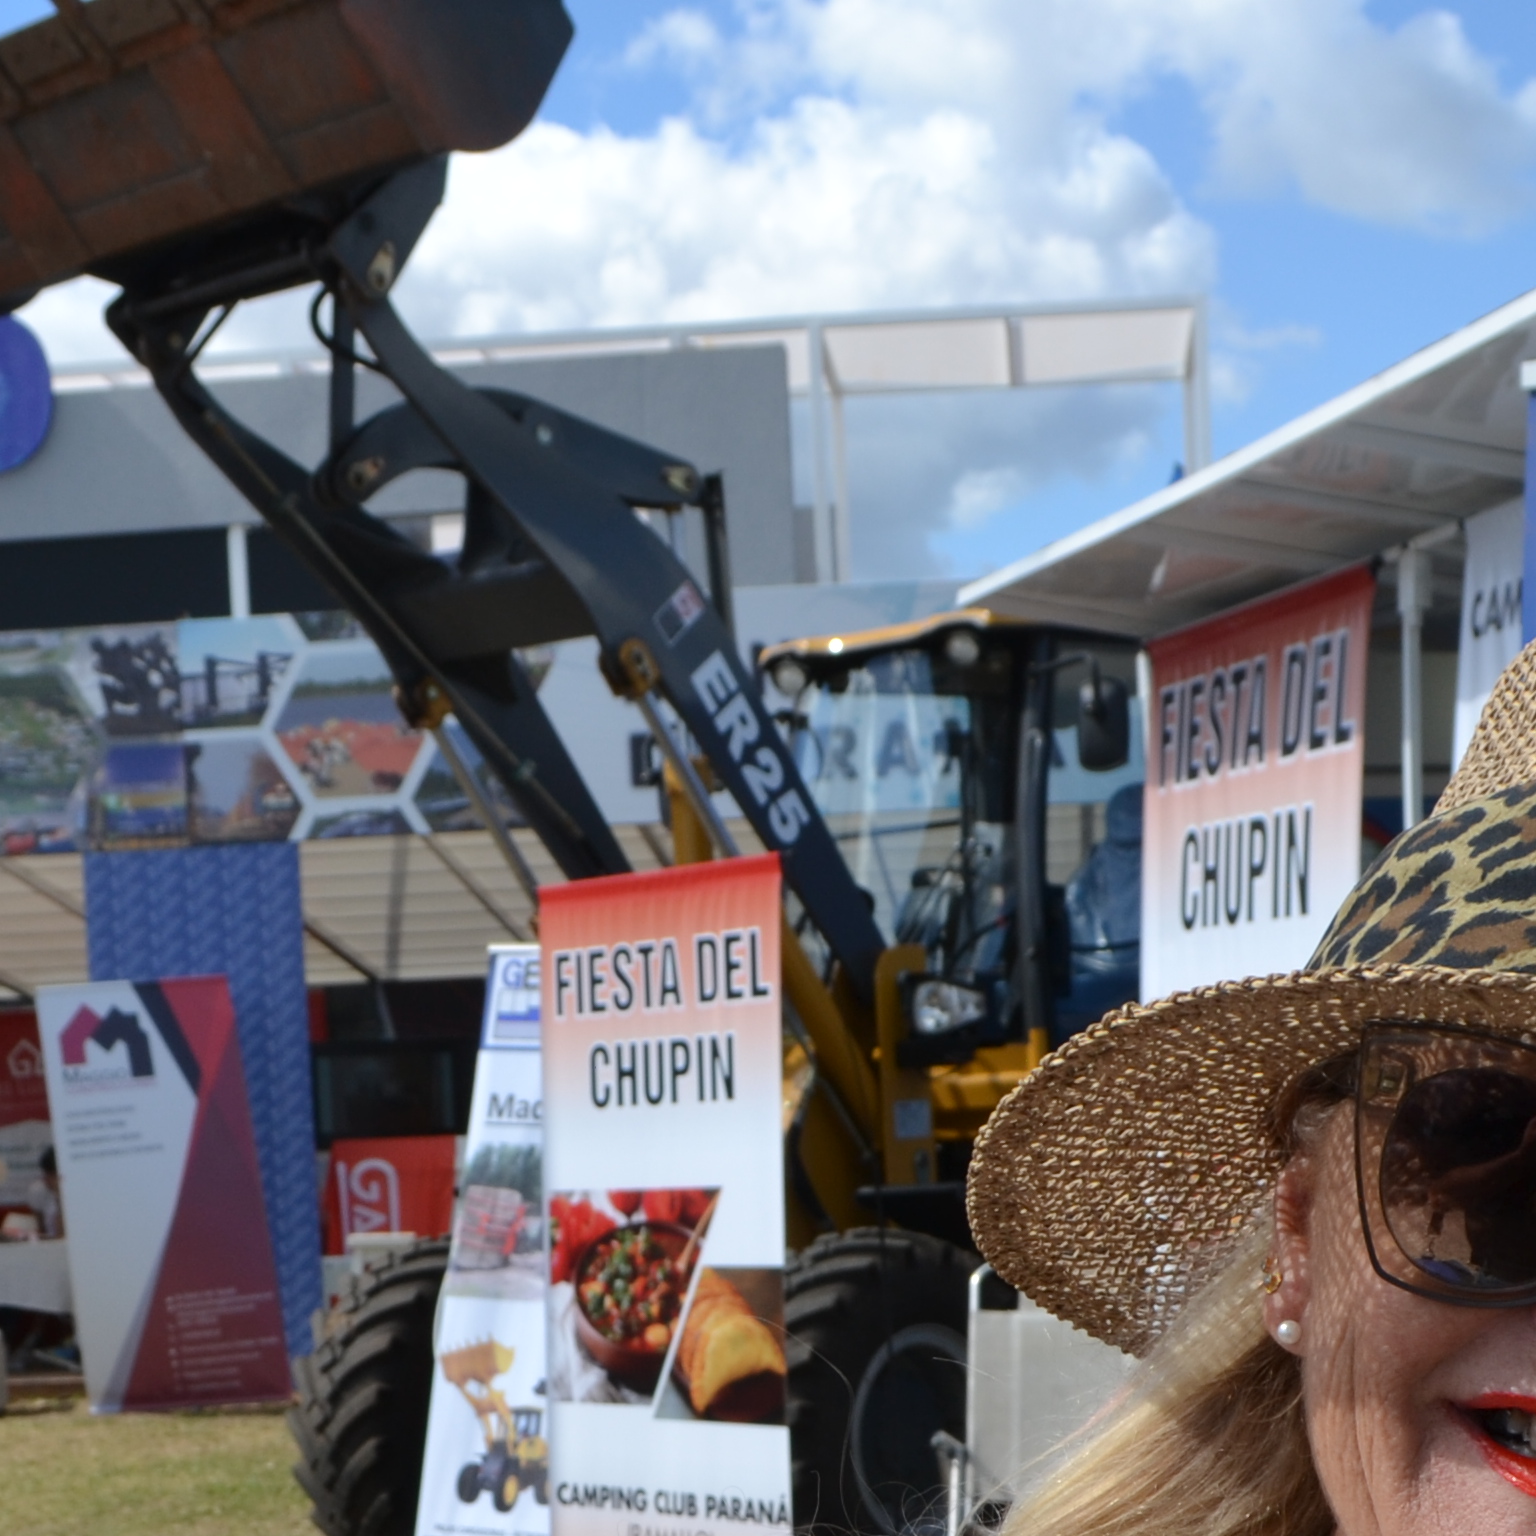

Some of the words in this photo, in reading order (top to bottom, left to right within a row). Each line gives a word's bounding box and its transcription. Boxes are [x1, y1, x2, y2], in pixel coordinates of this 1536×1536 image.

[690, 649, 810, 845] ER25
[1159, 650, 1268, 790] FIESTA
[1278, 629, 1357, 760] DEL
[1178, 808, 1314, 931] CHUPIN
[553, 938, 686, 1019] FIESTA
[694, 928, 771, 1002] DEL
[589, 1033, 736, 1109] CHUPIN
[557, 1483, 648, 1512] CAMPING
[654, 1489, 698, 1516] CLUB
[706, 1493, 789, 1525] PARANÁ
